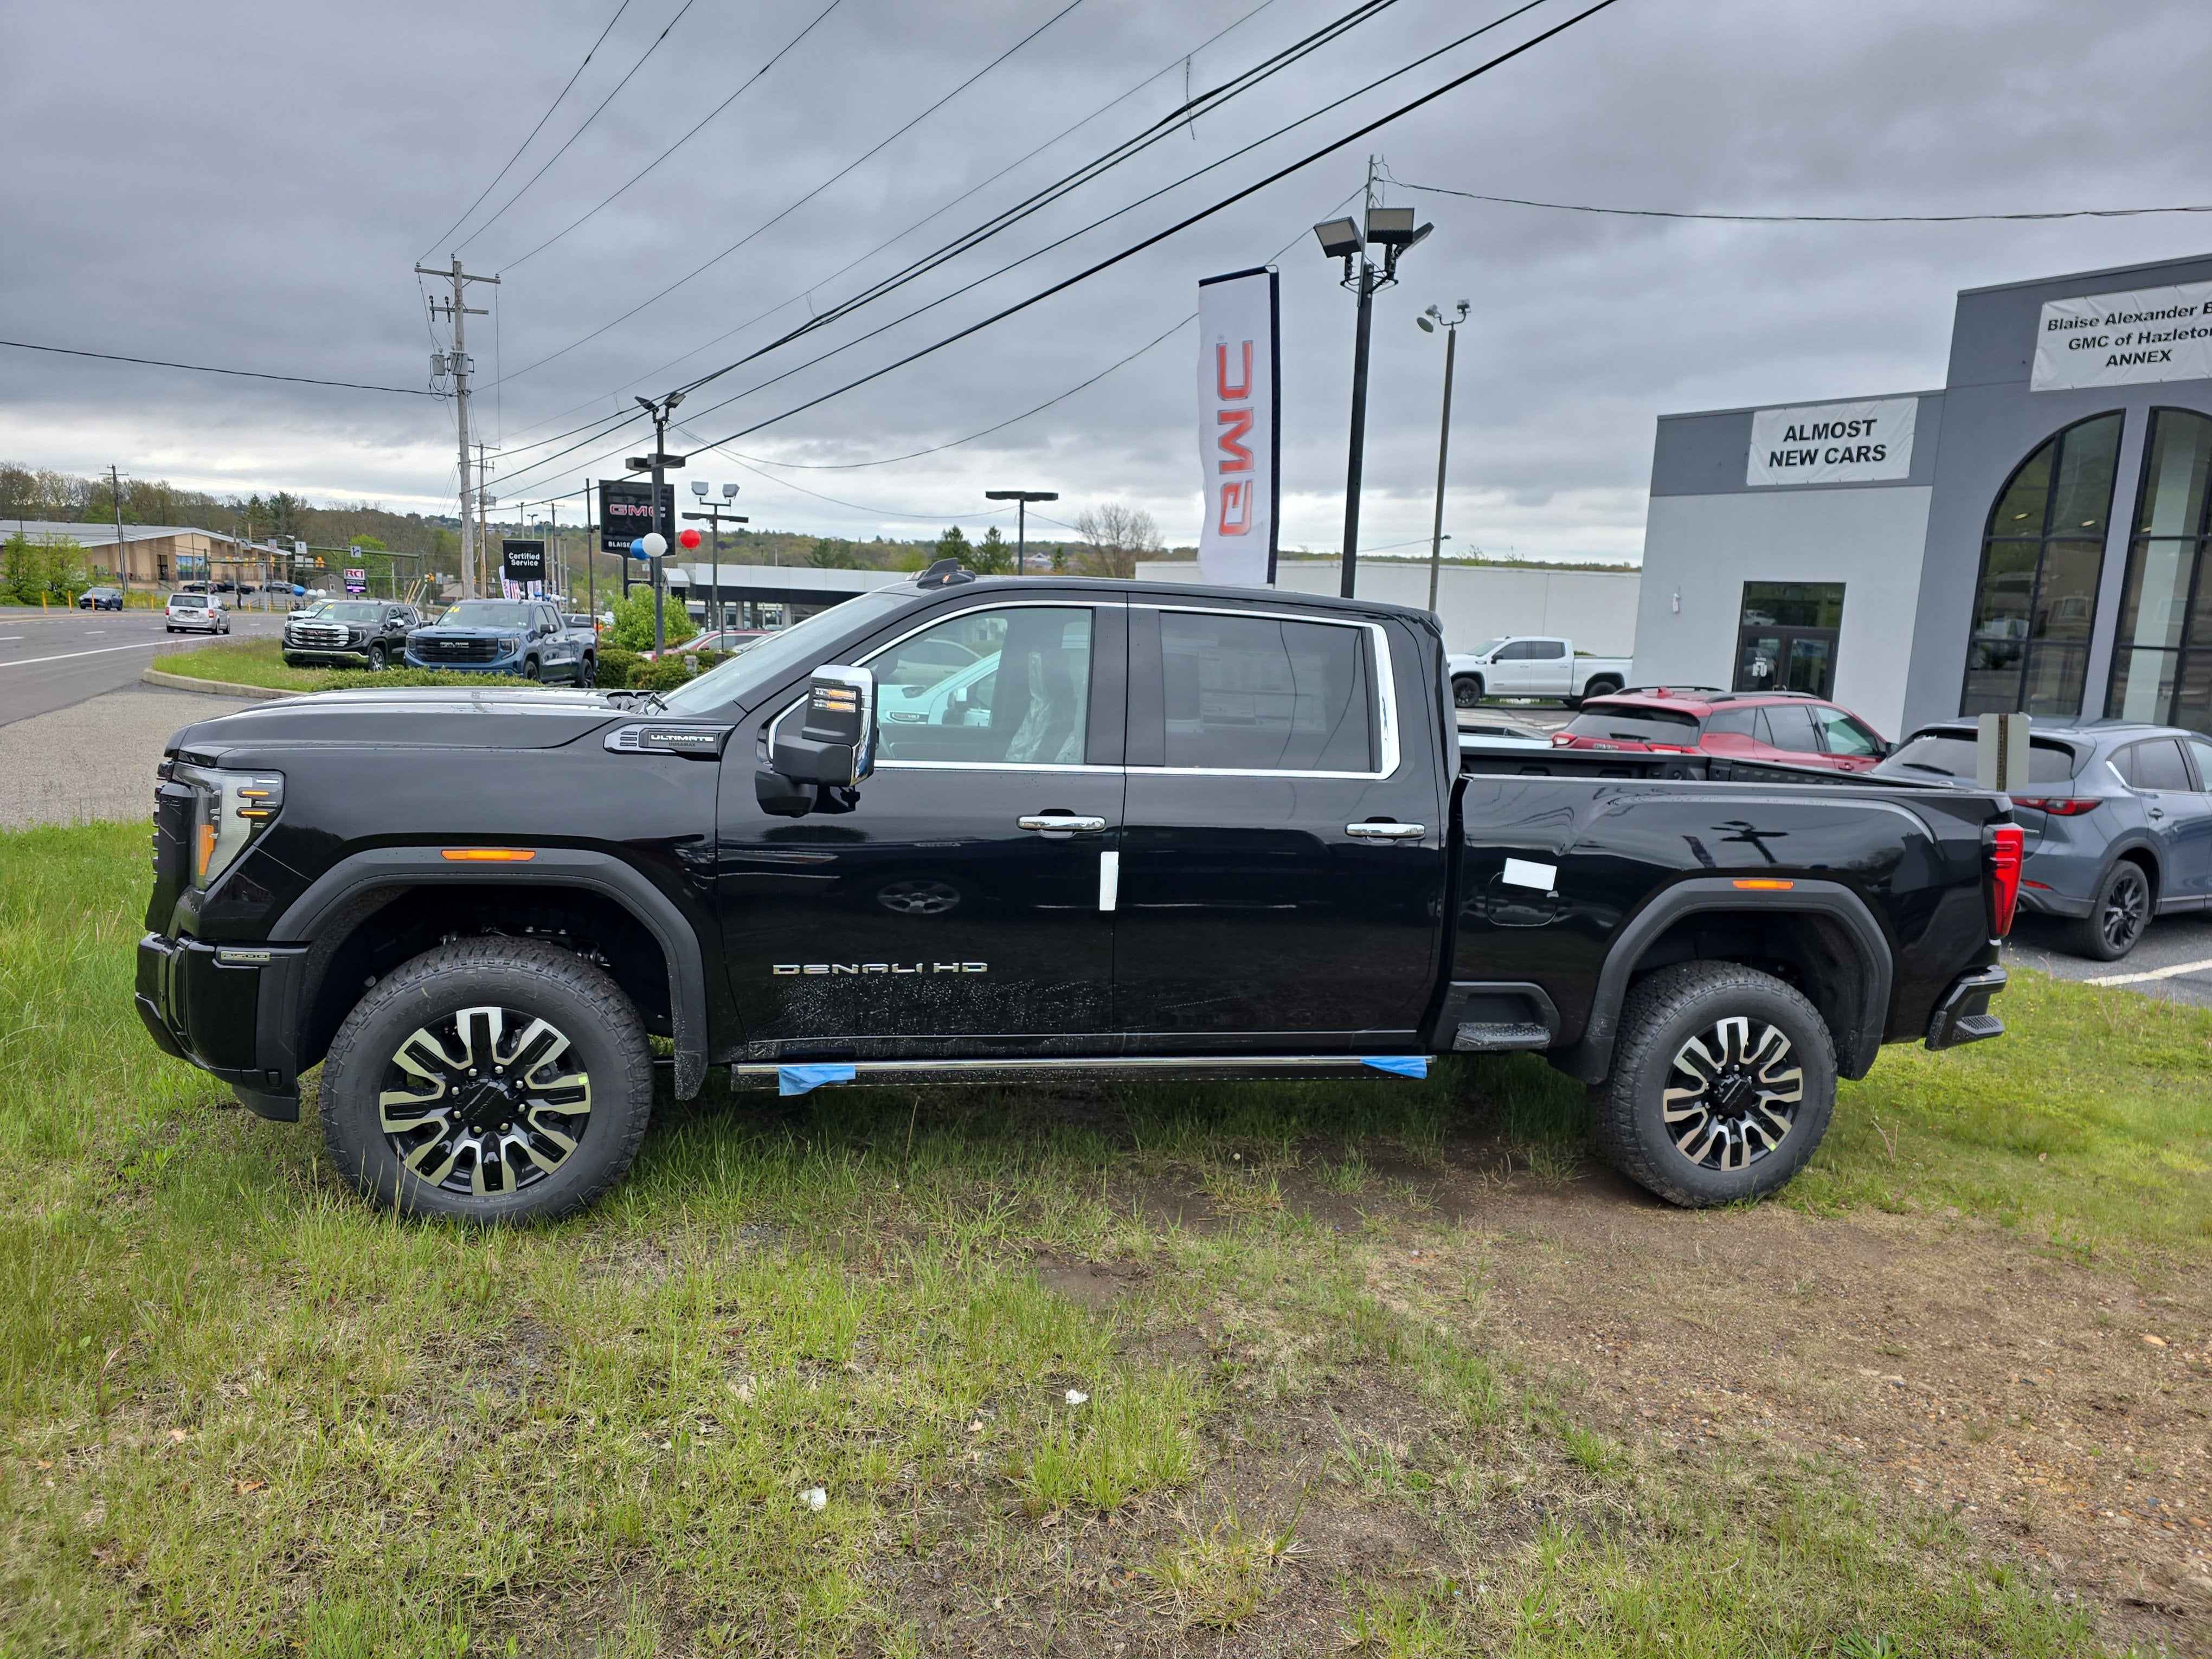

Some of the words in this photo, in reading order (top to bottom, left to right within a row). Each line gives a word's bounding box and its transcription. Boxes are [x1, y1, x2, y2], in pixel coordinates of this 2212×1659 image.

[2047, 316, 2100, 331] Blaise
[2104, 305, 2197, 325] Alexander
[2068, 335, 2110, 350] GMC
[2114, 332, 2133, 346] of
[2105, 349, 2173, 367] ANNEX
[1783, 418, 1877, 442] ALMOST
[1769, 448, 1819, 467] NEW
[1824, 444, 1887, 465] CARS
[609, 504, 666, 518] GMC
[773, 963, 923, 975] DENALI
[934, 962, 988, 974] HD
